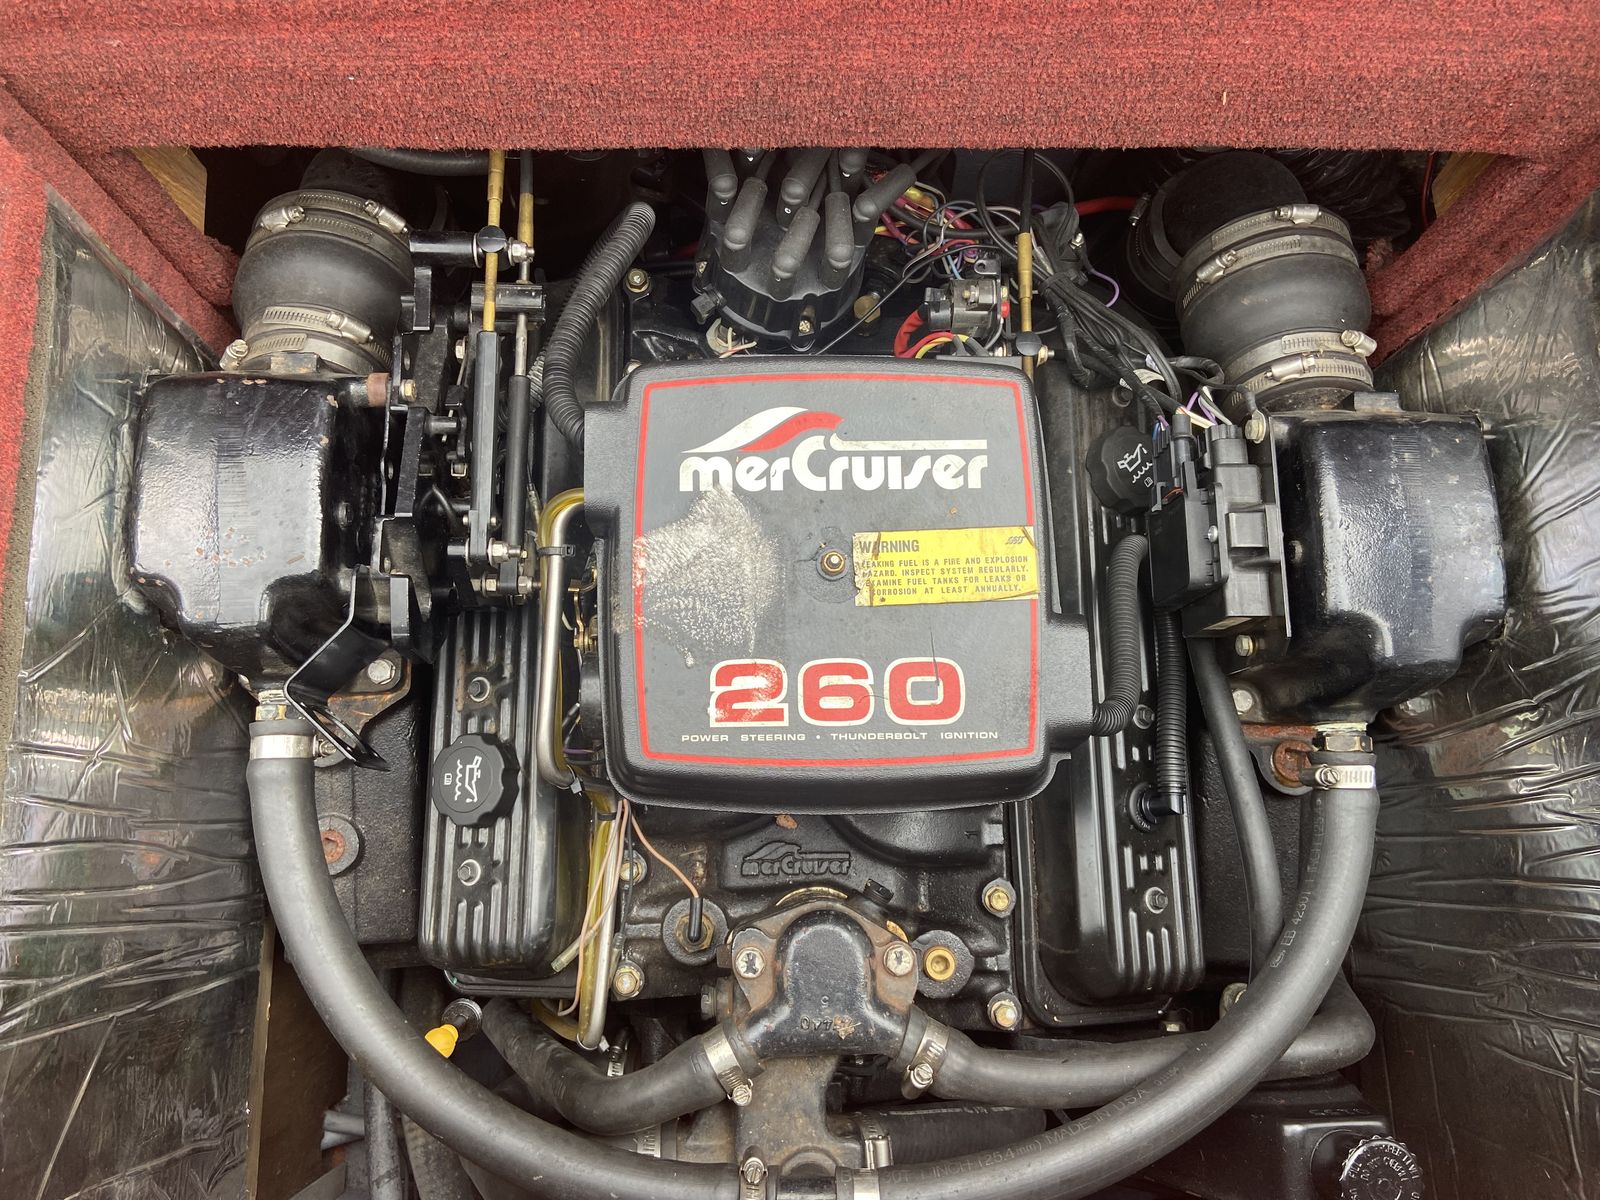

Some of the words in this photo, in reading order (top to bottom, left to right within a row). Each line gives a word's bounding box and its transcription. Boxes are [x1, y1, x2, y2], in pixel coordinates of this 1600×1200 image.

[898, 559, 918, 567] FUEL
[922, 558, 930, 566] IS
[934, 558, 940, 566] A
[943, 557, 961, 565] FIRE
[965, 557, 981, 565] AND
[984, 555, 1028, 564] EXPLOSION
[901, 568, 936, 577] INSPECT
[940, 567, 974, 575] SYSTEM
[978, 565, 1029, 574] REGULARLY.
[866, 578, 902, 587] EXAMINE
[907, 578, 927, 586] FUEL
[932, 576, 958, 585] TANKS
[963, 576, 979, 584] FOR
[984, 575, 1011, 583] LEAKS
[1016, 574, 1027, 582] OR
[924, 587, 934, 595] AT
[941, 585, 968, 594] LEAST
[975, 584, 1022, 593] ANNUALLY.
[708, 657, 966, 728] 260
[681, 734, 729, 743] POWER
[740, 733, 806, 742] STEERING
[830, 732, 928, 741] THUNDERBOLT
[940, 731, 999, 740] IGNITION
[1045, 1119, 1092, 1146] MADE
